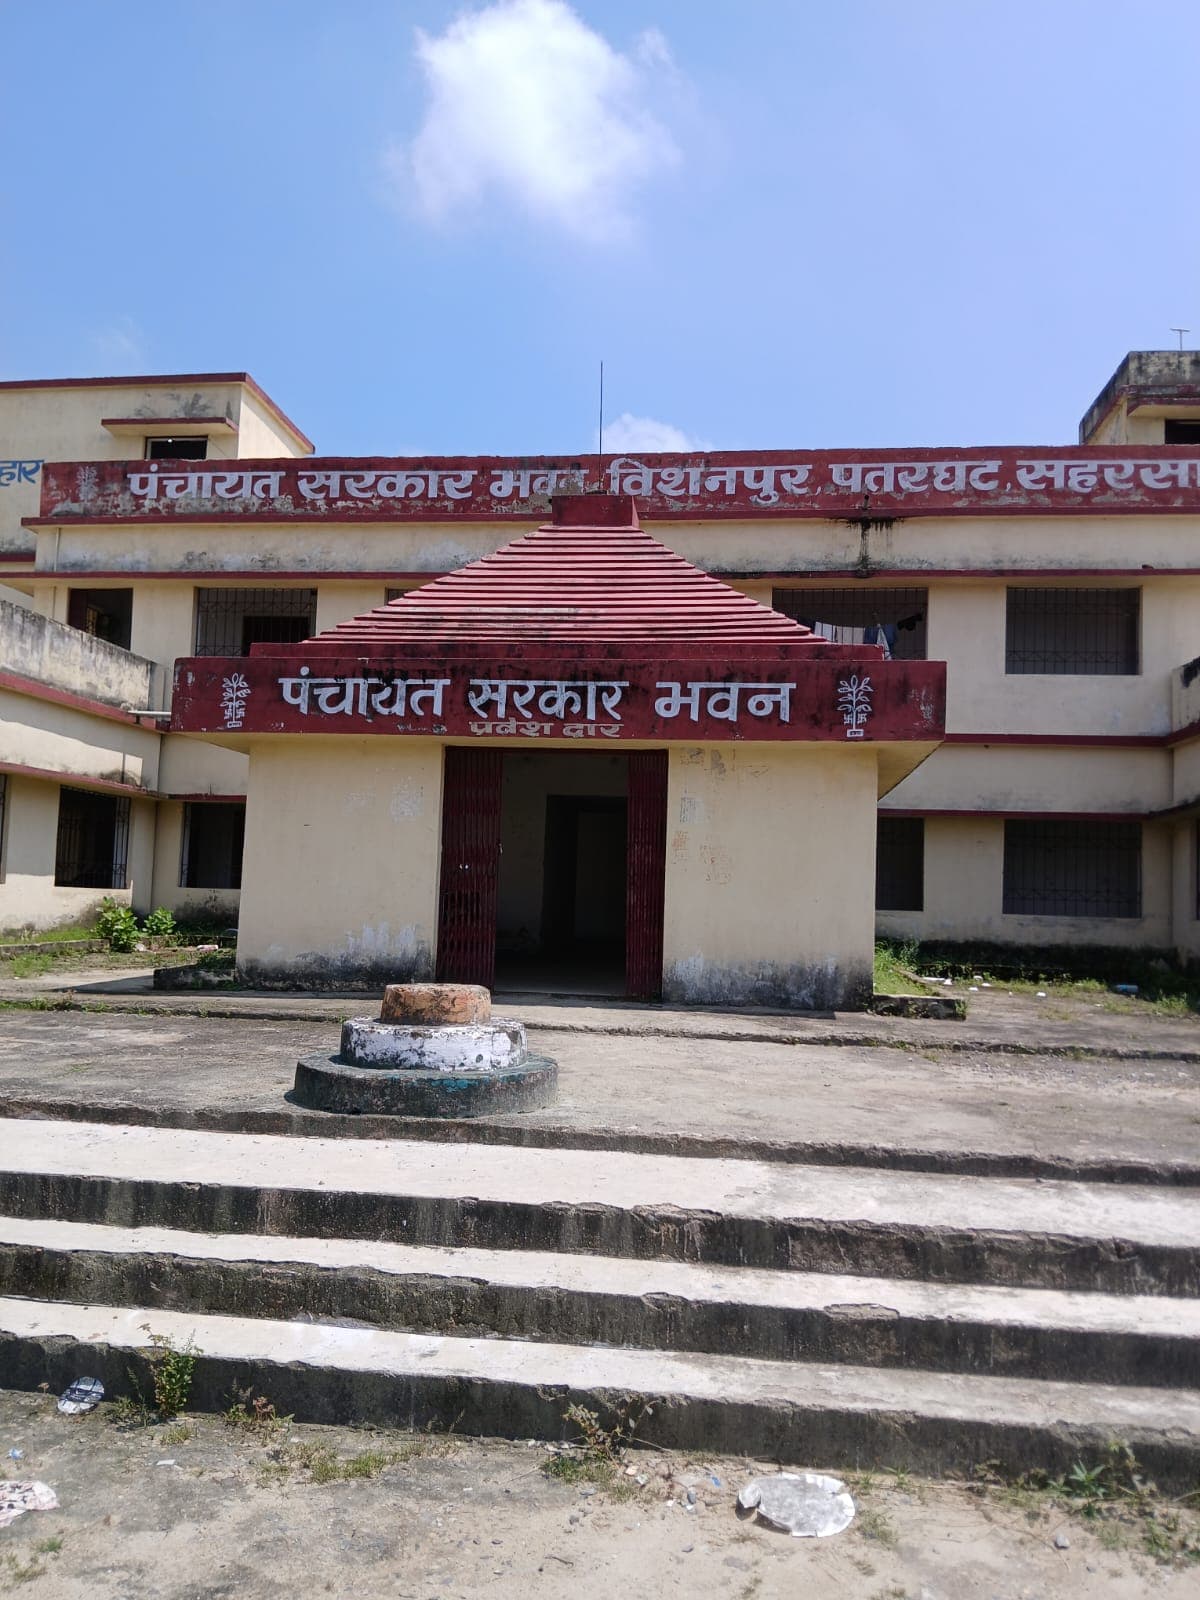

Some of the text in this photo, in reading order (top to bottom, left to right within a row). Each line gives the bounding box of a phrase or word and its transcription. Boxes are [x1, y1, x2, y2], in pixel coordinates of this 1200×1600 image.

[126, 464, 286, 500] पंचायत
[297, 470, 478, 500] सरकार
[278, 667, 797, 722] पंचायत सरकार भवन
